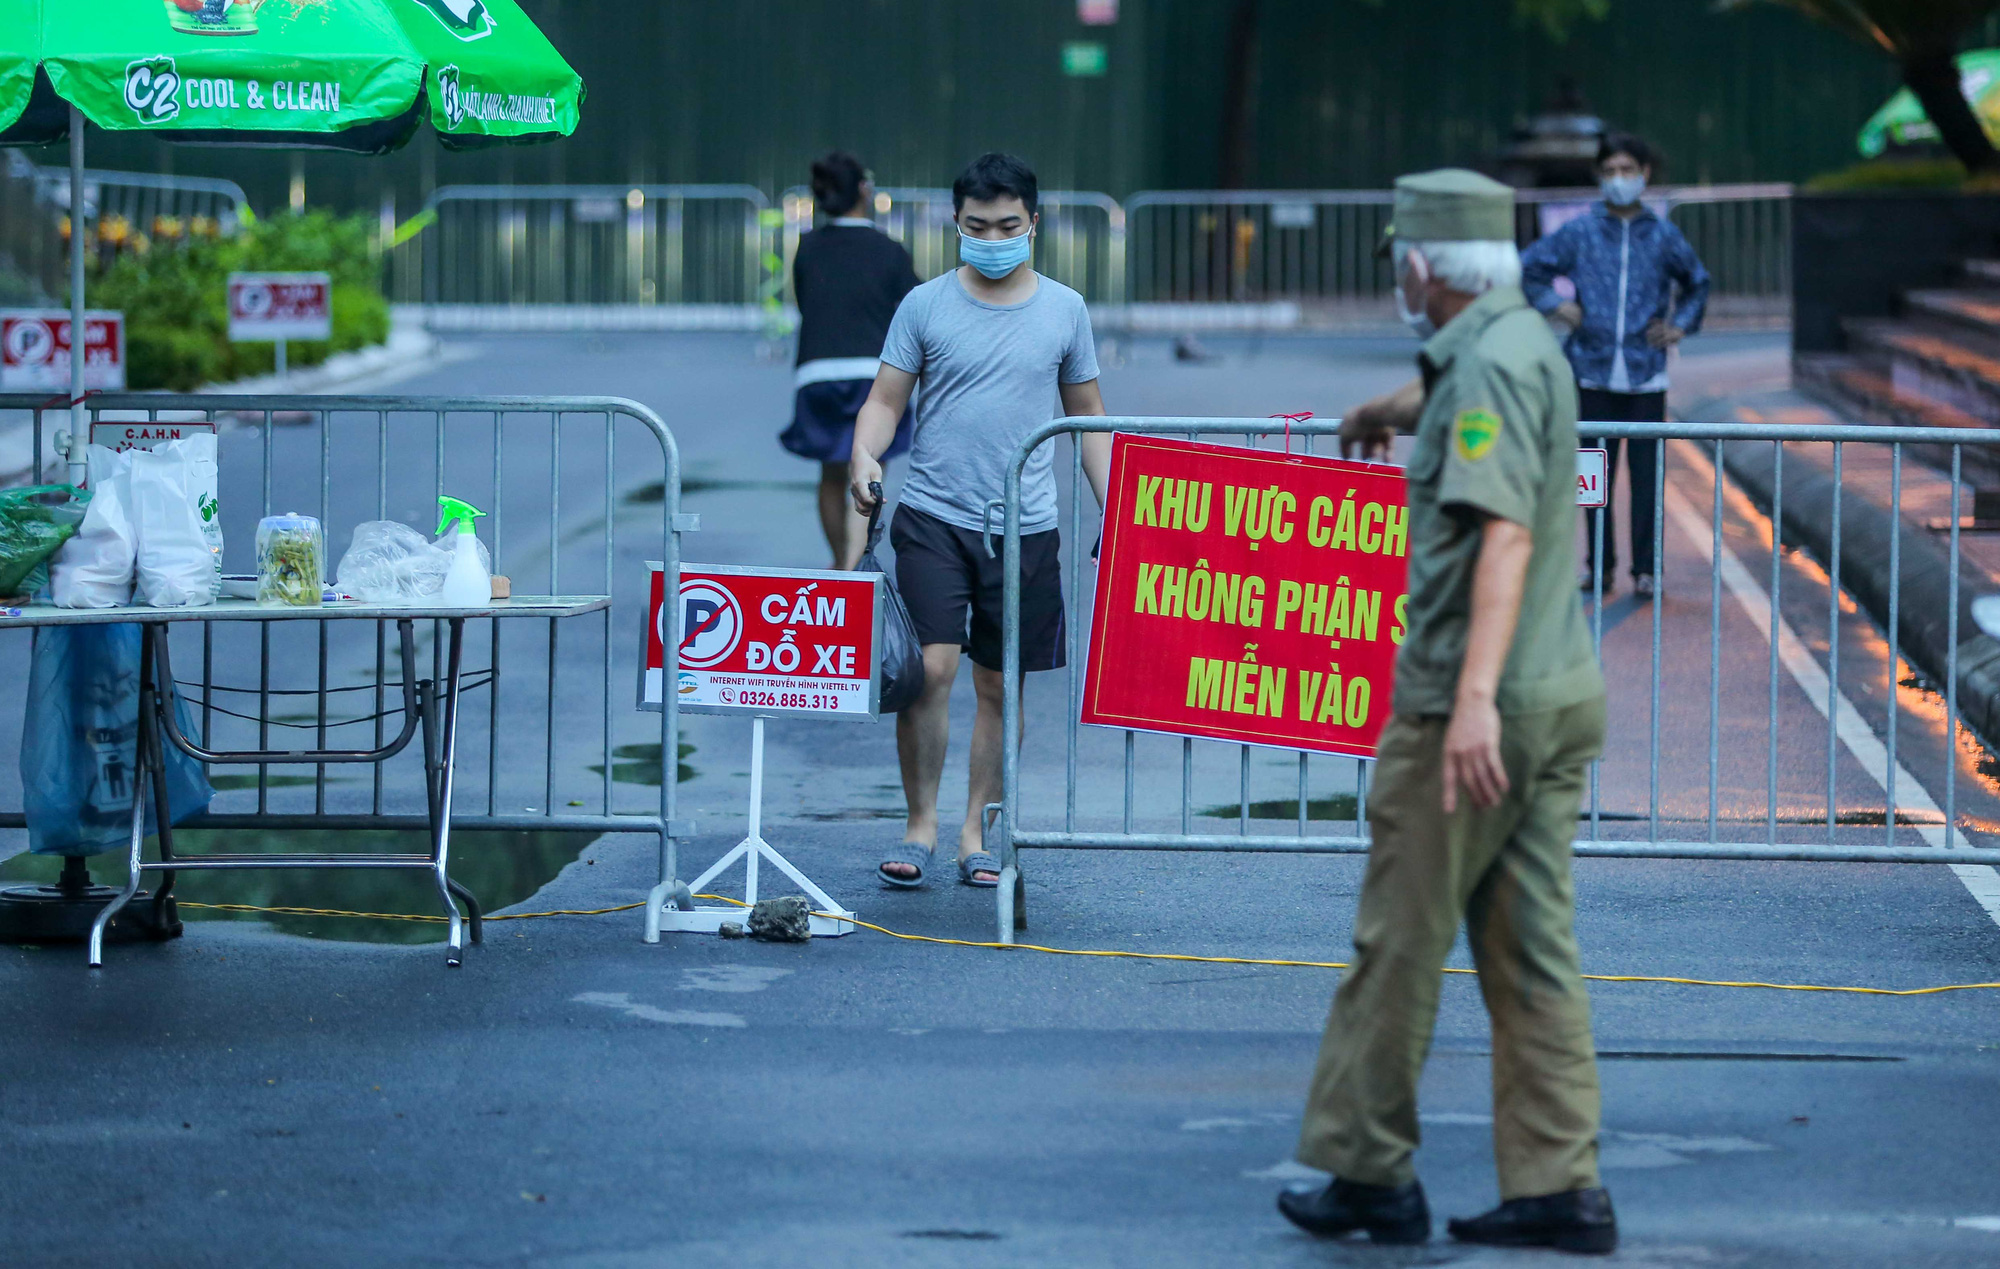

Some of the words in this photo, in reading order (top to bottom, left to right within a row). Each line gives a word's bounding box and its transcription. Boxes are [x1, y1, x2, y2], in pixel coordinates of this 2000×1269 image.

[127, 66, 179, 118] C2
[185, 78, 240, 109] COOL
[247, 79, 266, 110] &
[272, 80, 340, 112] CLEAN
[125, 428, 180, 439] C.A.H.N
[1576, 474, 1596, 495] ẠI
[1133, 474, 1213, 533] KHU
[1224, 484, 1297, 551] VỰC
[1307, 488, 1410, 557] CÁCH
[760, 582, 847, 628] CẤM
[1134, 558, 1266, 628] KHÔNG
[1275, 575, 1382, 650] PHẬN
[1390, 594, 1410, 646] S
[745, 628, 801, 673] ĐỖ
[811, 644, 857, 676] XE
[710, 676, 746, 686] INTERNET
[747, 678, 764, 687] WIFI
[820, 682, 849, 691] VIETTEL
[850, 683, 861, 692] TV
[739, 690, 839, 710] 0326.885.313
[1185, 642, 1287, 719] MIỄN
[1299, 662, 1371, 729] VÀO
